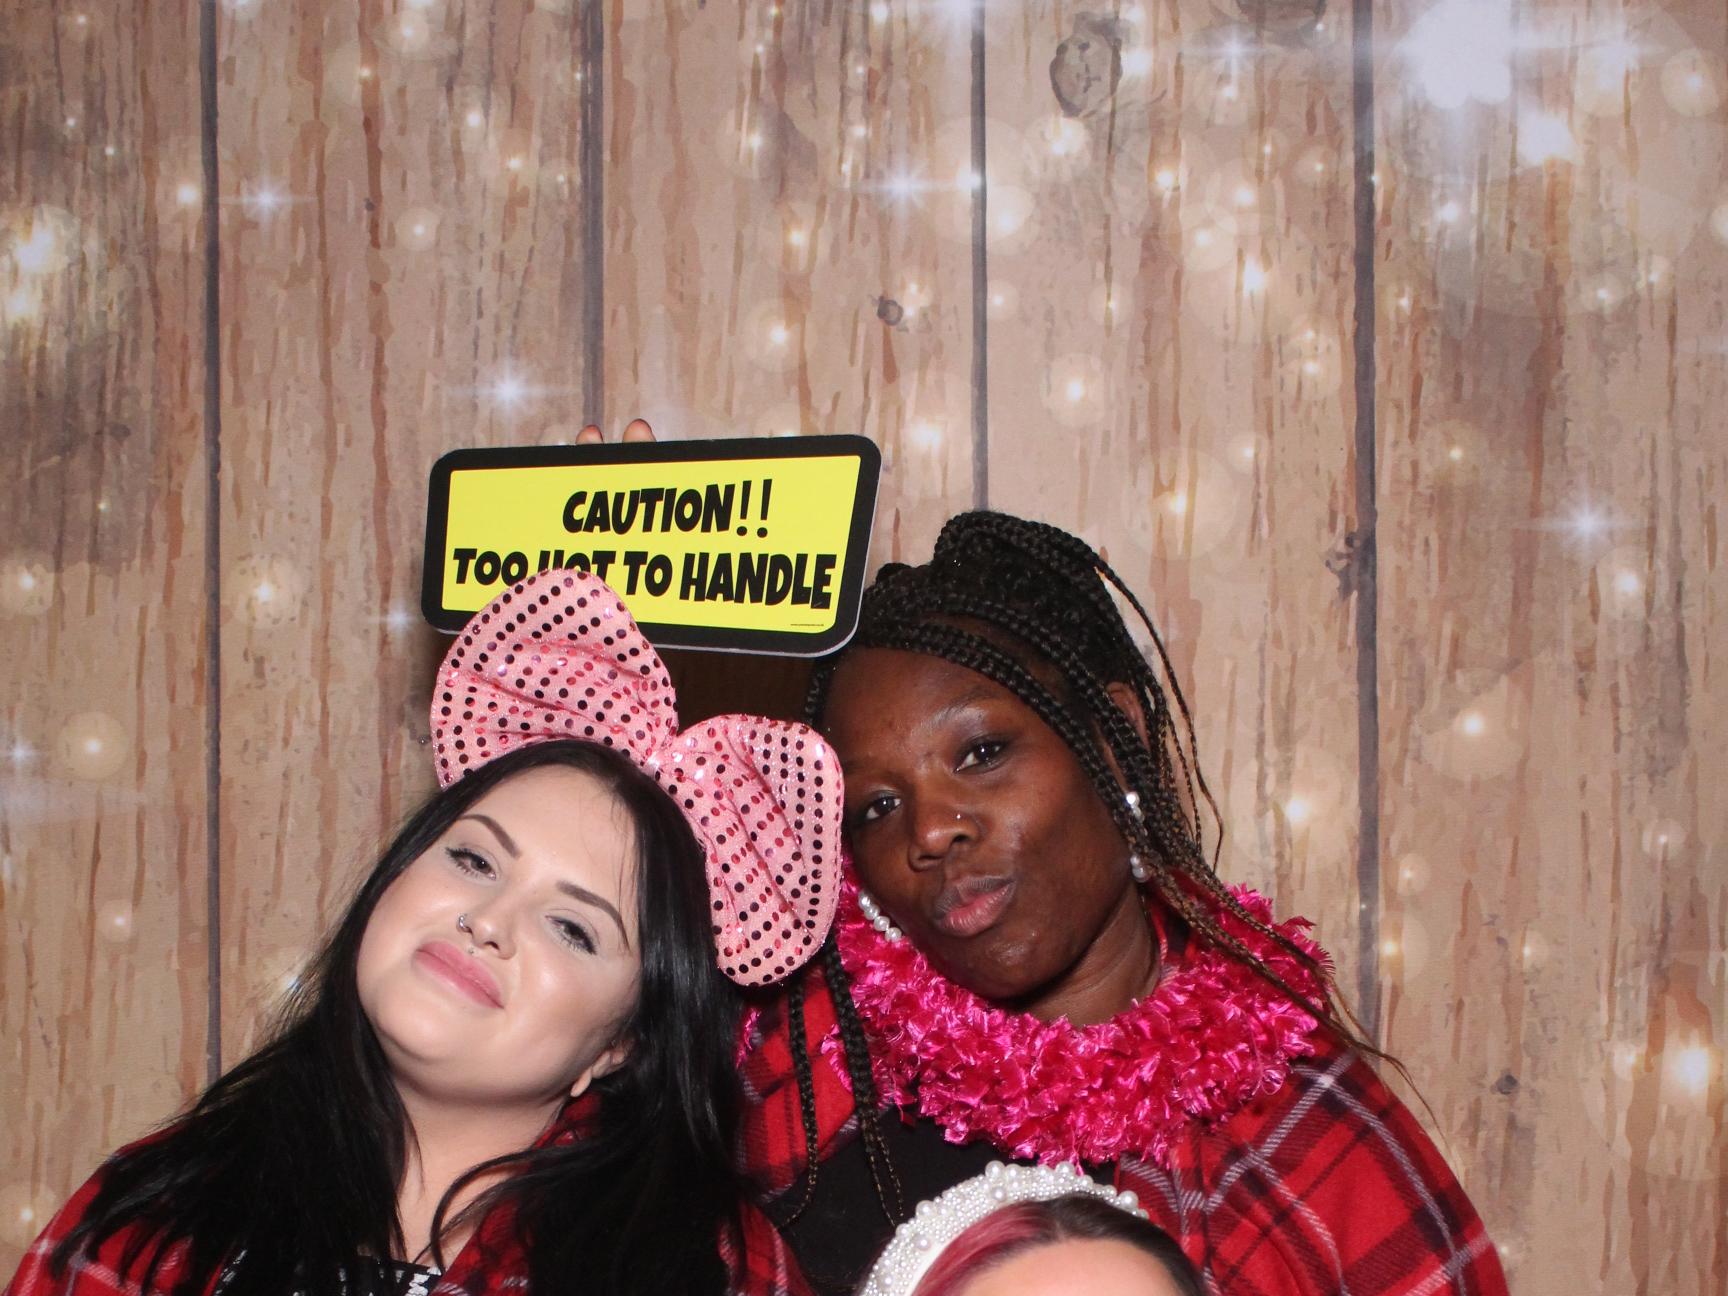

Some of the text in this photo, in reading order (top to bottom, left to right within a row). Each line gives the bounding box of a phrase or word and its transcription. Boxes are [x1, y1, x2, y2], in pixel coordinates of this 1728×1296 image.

[562, 478, 773, 538] CAUTION!!
[452, 548, 529, 587] TOO
[623, 550, 673, 597] TO
[679, 551, 837, 610] HANDLE
